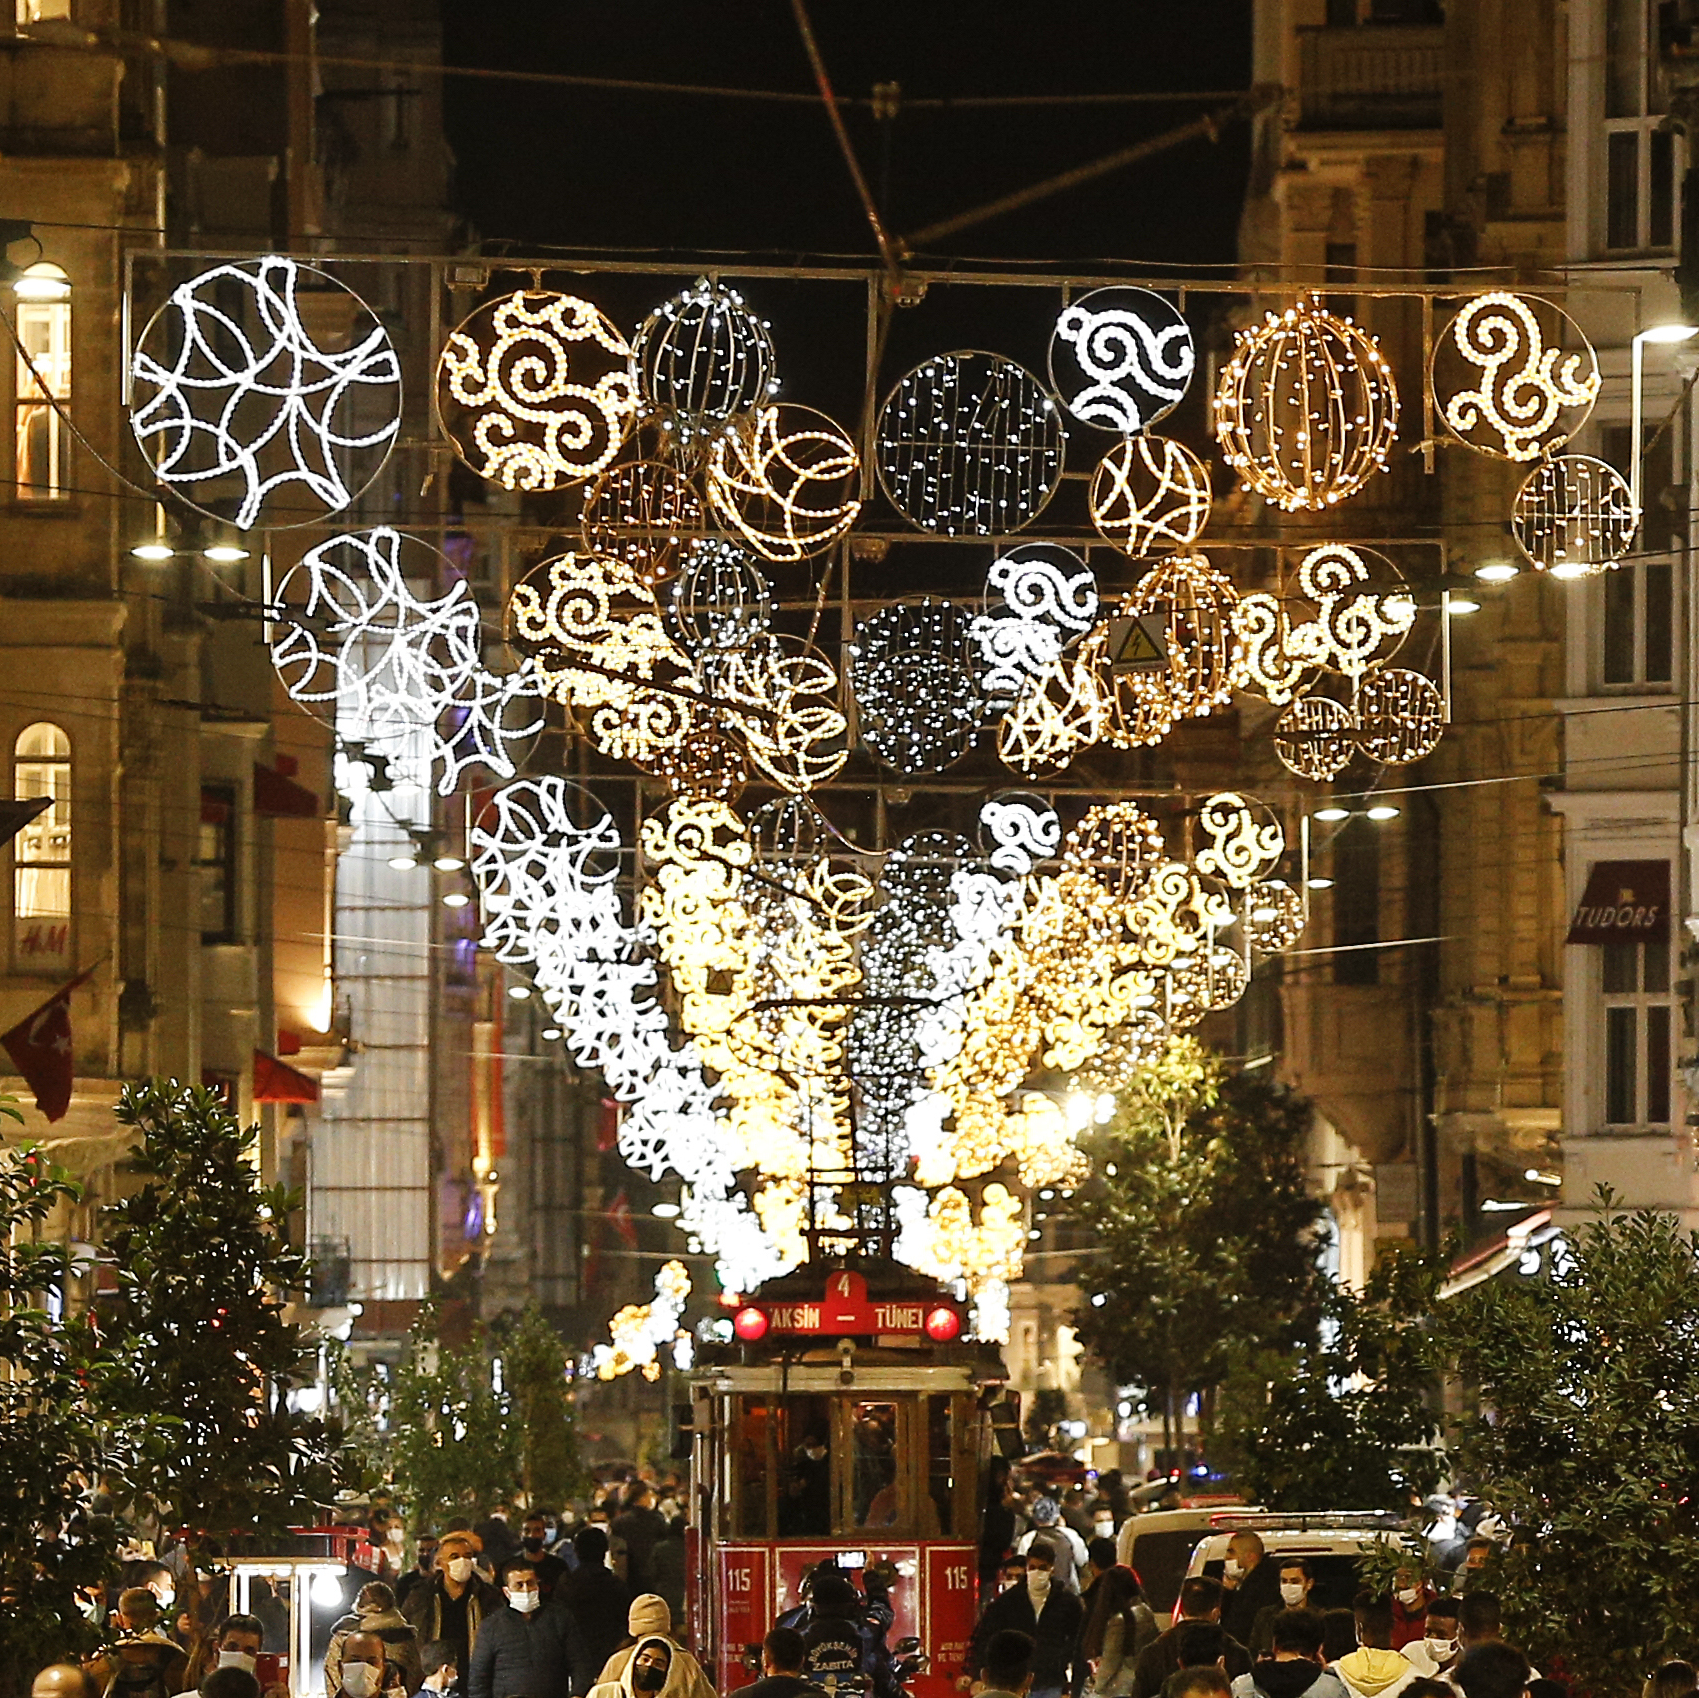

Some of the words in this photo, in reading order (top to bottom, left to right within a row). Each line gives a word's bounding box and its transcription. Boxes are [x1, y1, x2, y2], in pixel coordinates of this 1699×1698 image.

[1576, 906, 1659, 928] TUDORS
[836, 1273, 850, 1298] 4
[769, 1304, 820, 1328] AKSİM
[727, 1568, 751, 1591] 115
[944, 1566, 968, 1590] 115
